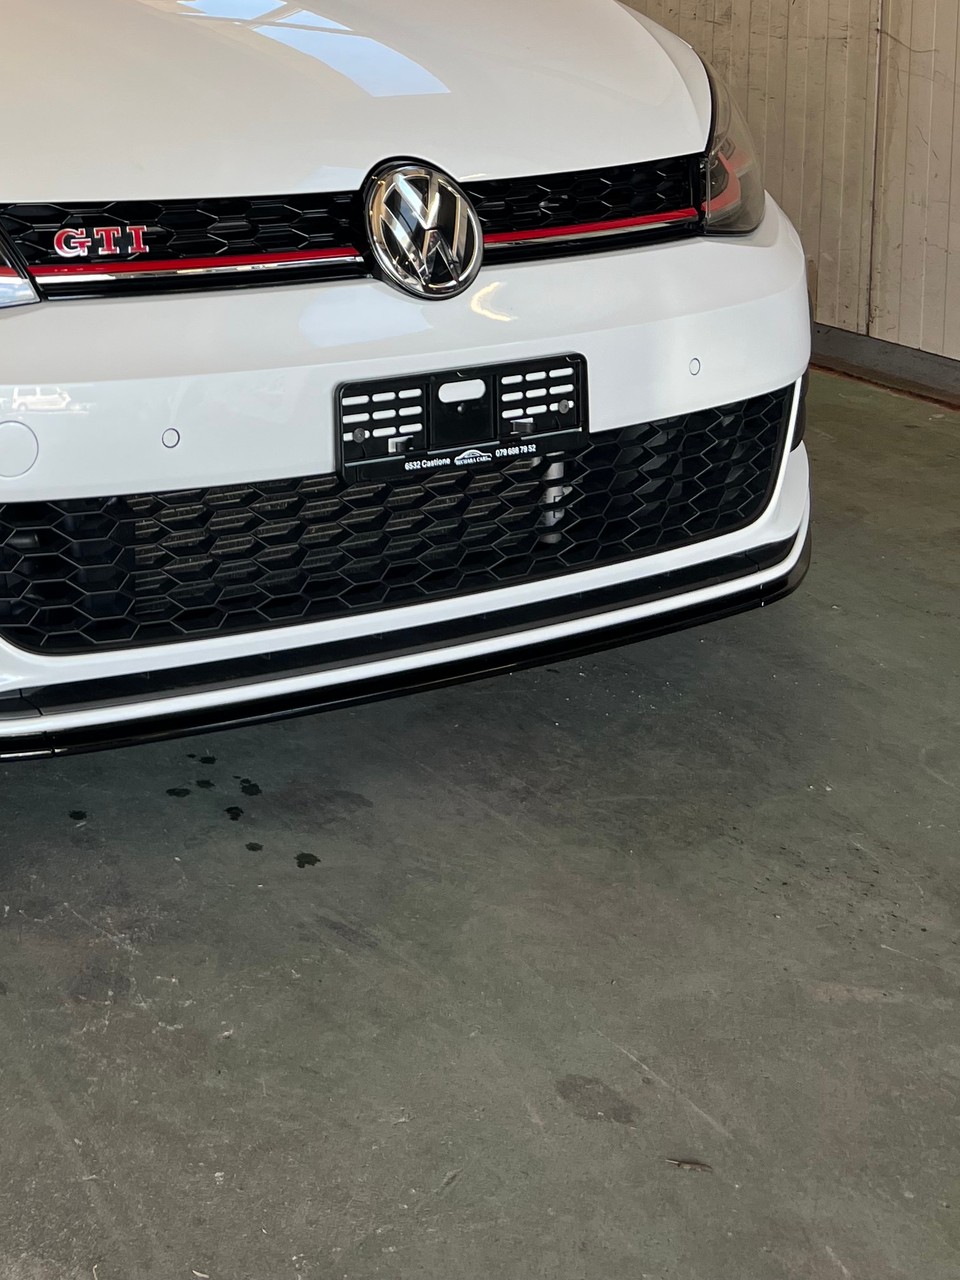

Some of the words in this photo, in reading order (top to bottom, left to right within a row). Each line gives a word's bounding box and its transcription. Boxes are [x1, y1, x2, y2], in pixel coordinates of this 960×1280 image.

[54, 225, 149, 258] GTI
[495, 448, 507, 458] 079
[528, 443, 537, 452] 52
[404, 461, 421, 471] 6532
[421, 457, 451, 468] Castione
